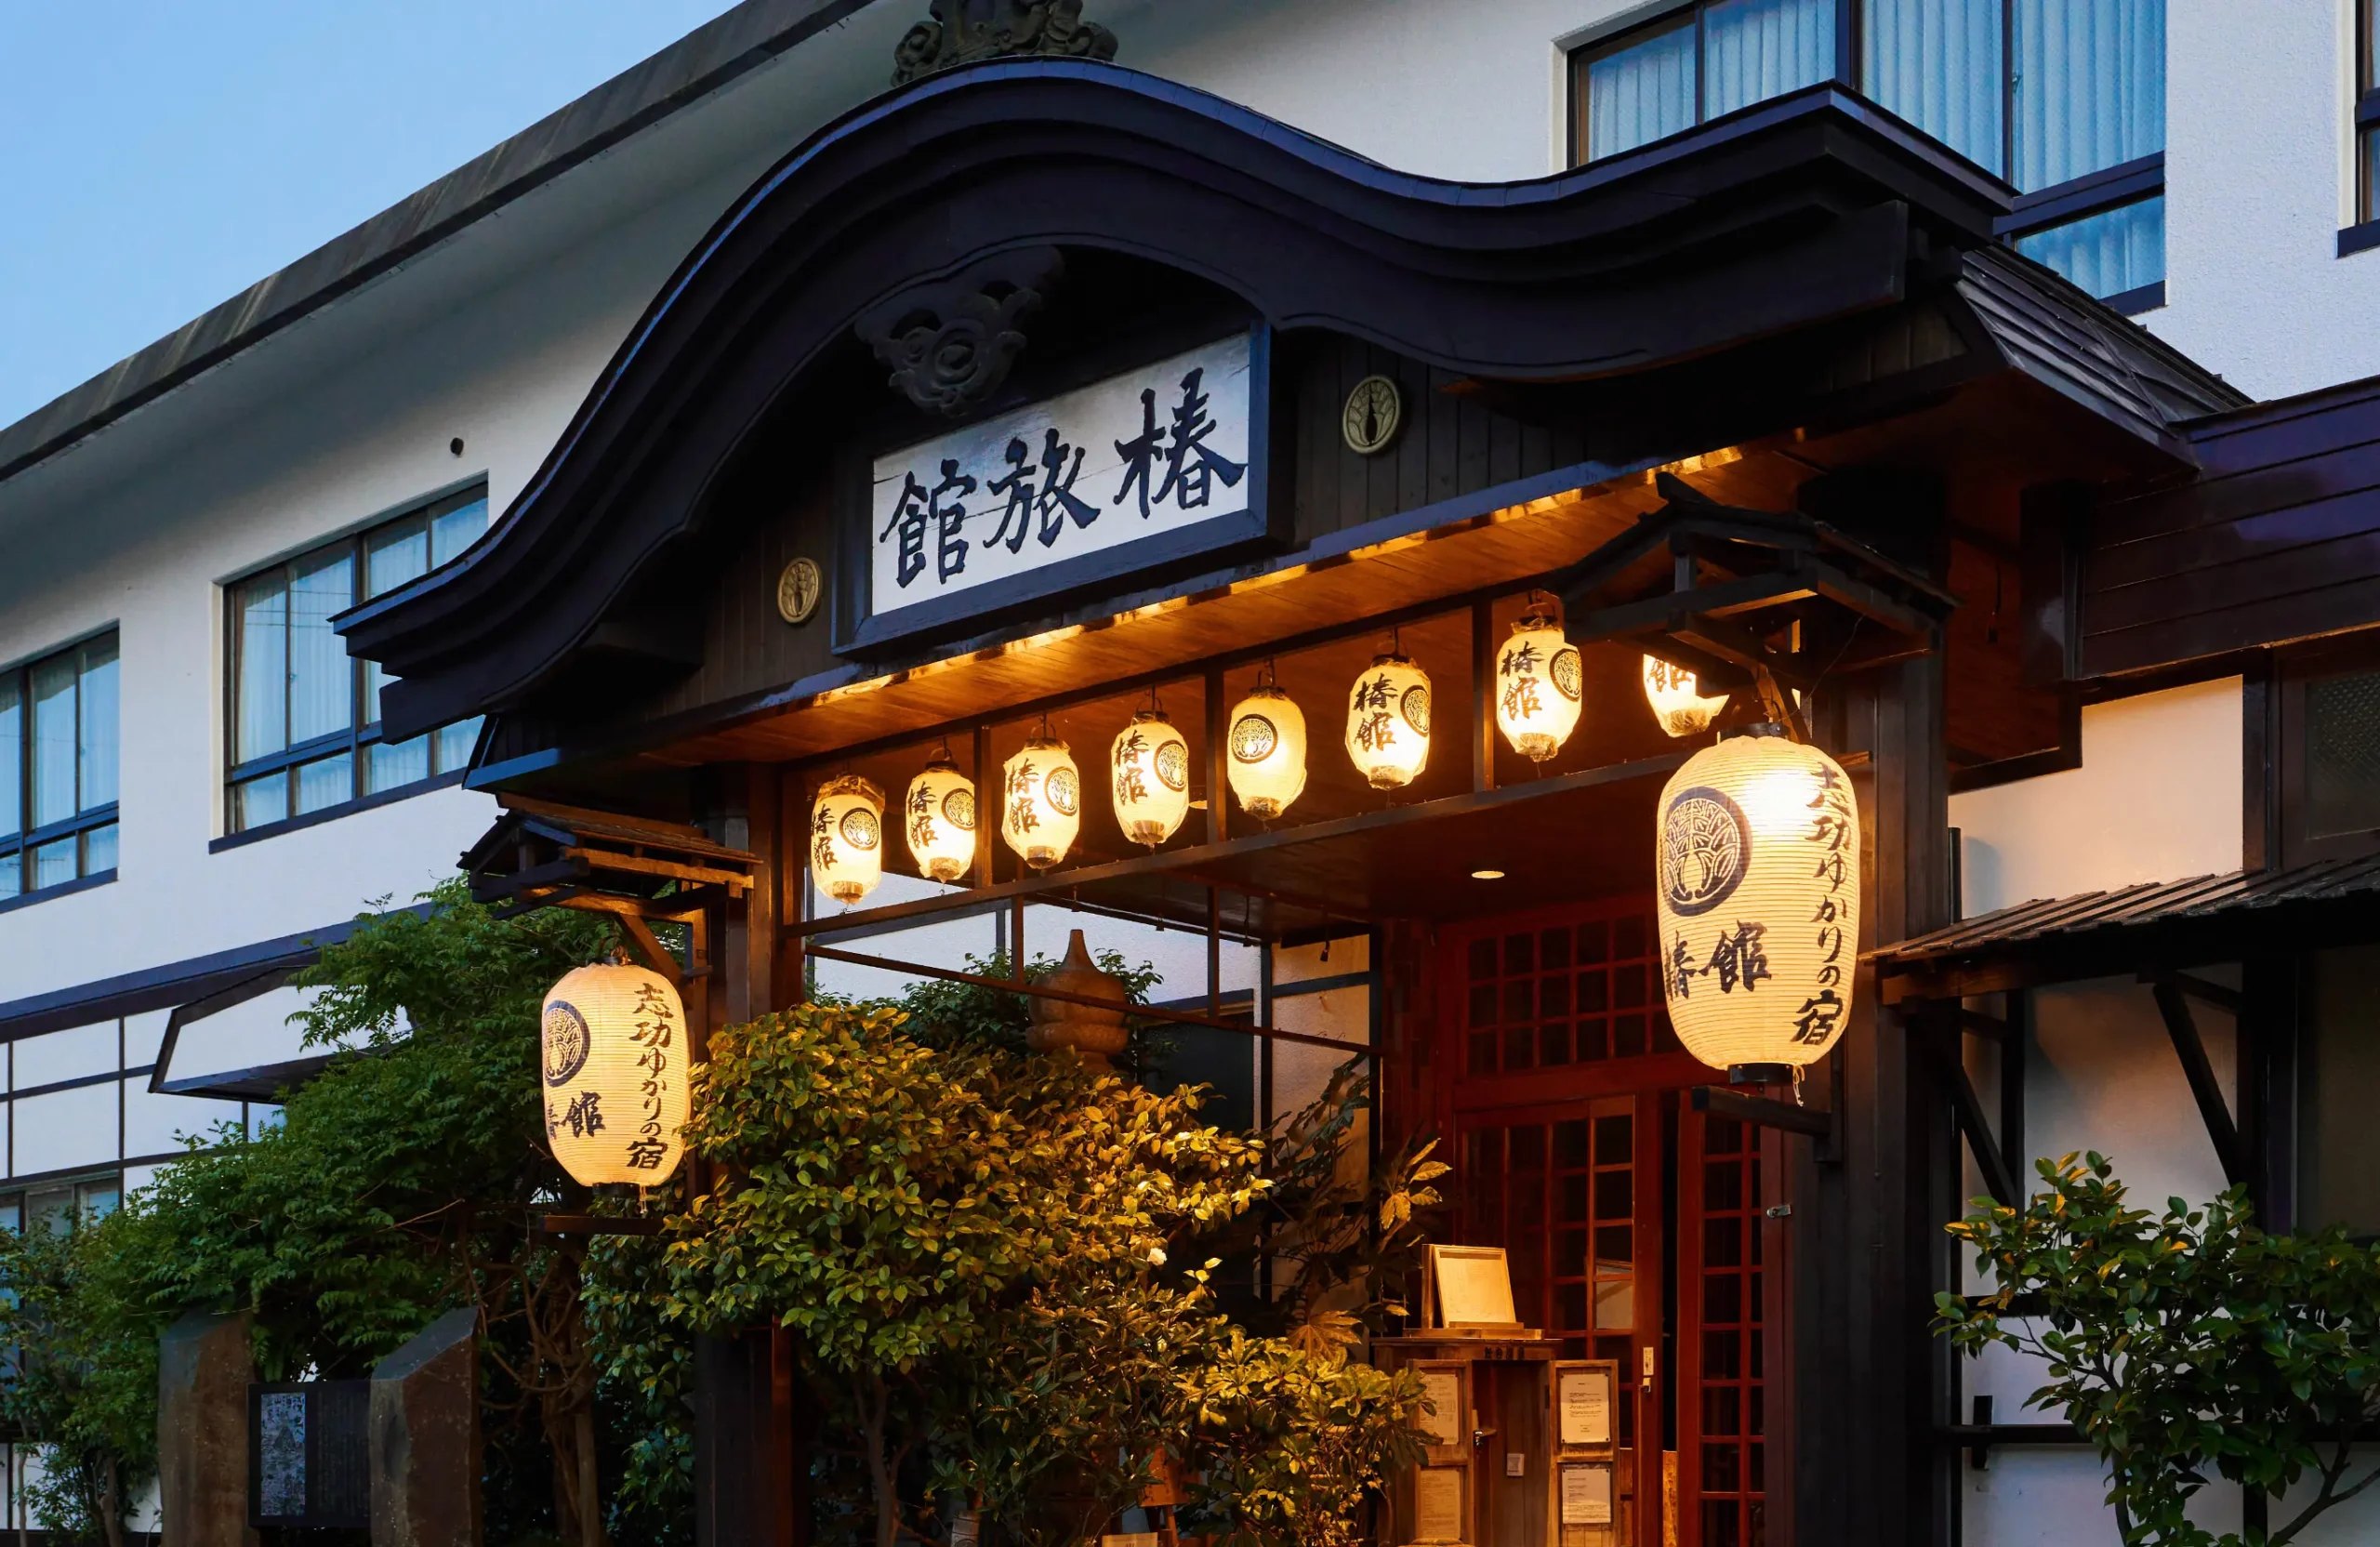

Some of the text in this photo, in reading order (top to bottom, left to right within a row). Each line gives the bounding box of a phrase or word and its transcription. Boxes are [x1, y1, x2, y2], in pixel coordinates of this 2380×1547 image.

[1352, 673, 1397, 752] 椿館
[1500, 641, 1543, 721] 椿館
[1006, 758, 1040, 835] 椿館
[1114, 730, 1149, 805] 椿館
[908, 781, 939, 848] 椿館
[1791, 760, 1852, 1045] 志功ゆかりの宿
[627, 983, 674, 1170] 志功ゆかりの宿
